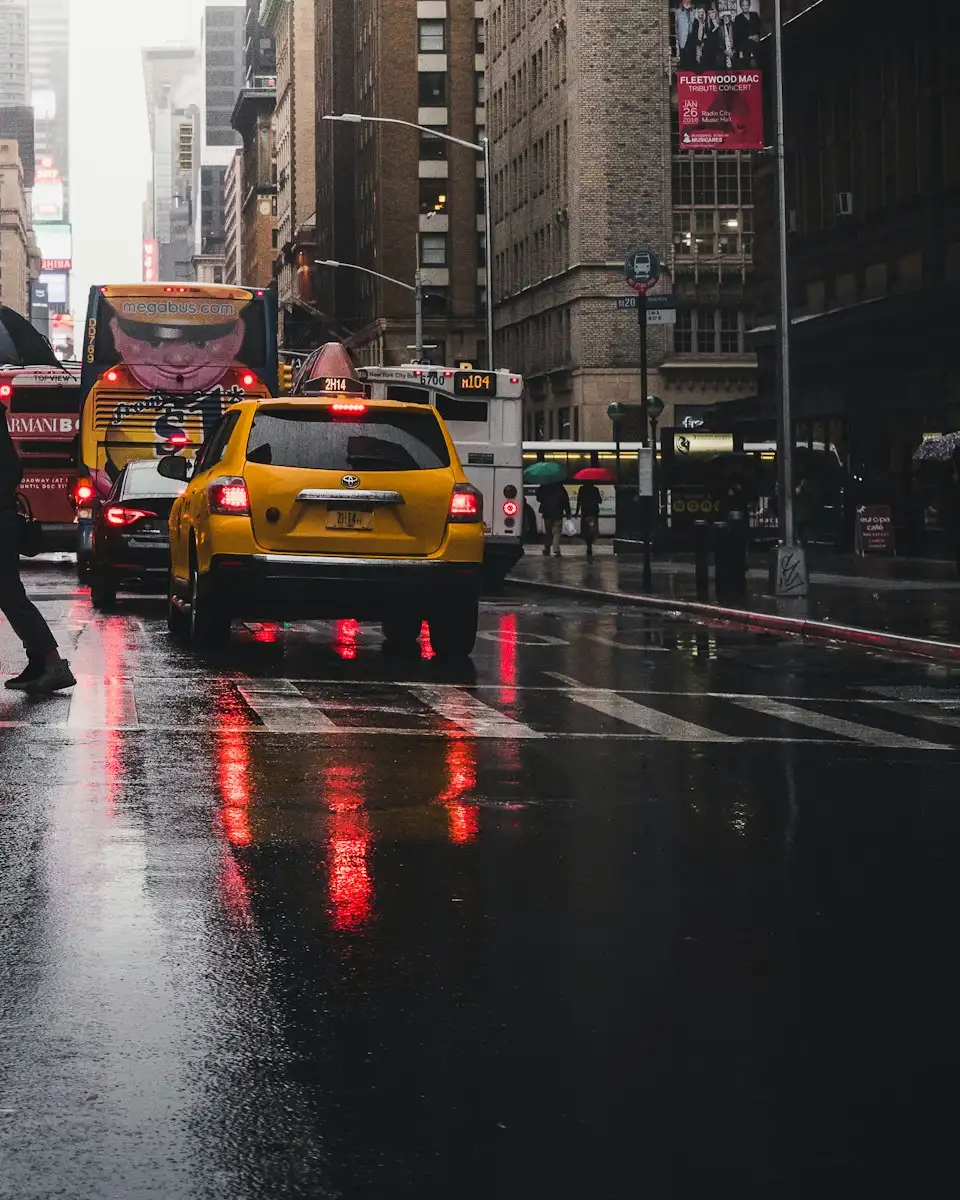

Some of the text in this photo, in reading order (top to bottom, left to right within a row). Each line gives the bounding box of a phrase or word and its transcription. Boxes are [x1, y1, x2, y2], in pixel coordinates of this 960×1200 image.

[680, 74, 759, 84] FLEETWOOD MAC
[718, 84, 751, 92] CONCERT
[683, 100, 698, 108] JAN
[683, 107, 698, 117] 26
[618, 298, 636, 308] M20
[123, 302, 235, 315] megabus.com
[86, 318, 97, 363] DD769
[325, 378, 347, 390] 2H14
[420, 375, 444, 386] 6700
[462, 375, 490, 389] M104
